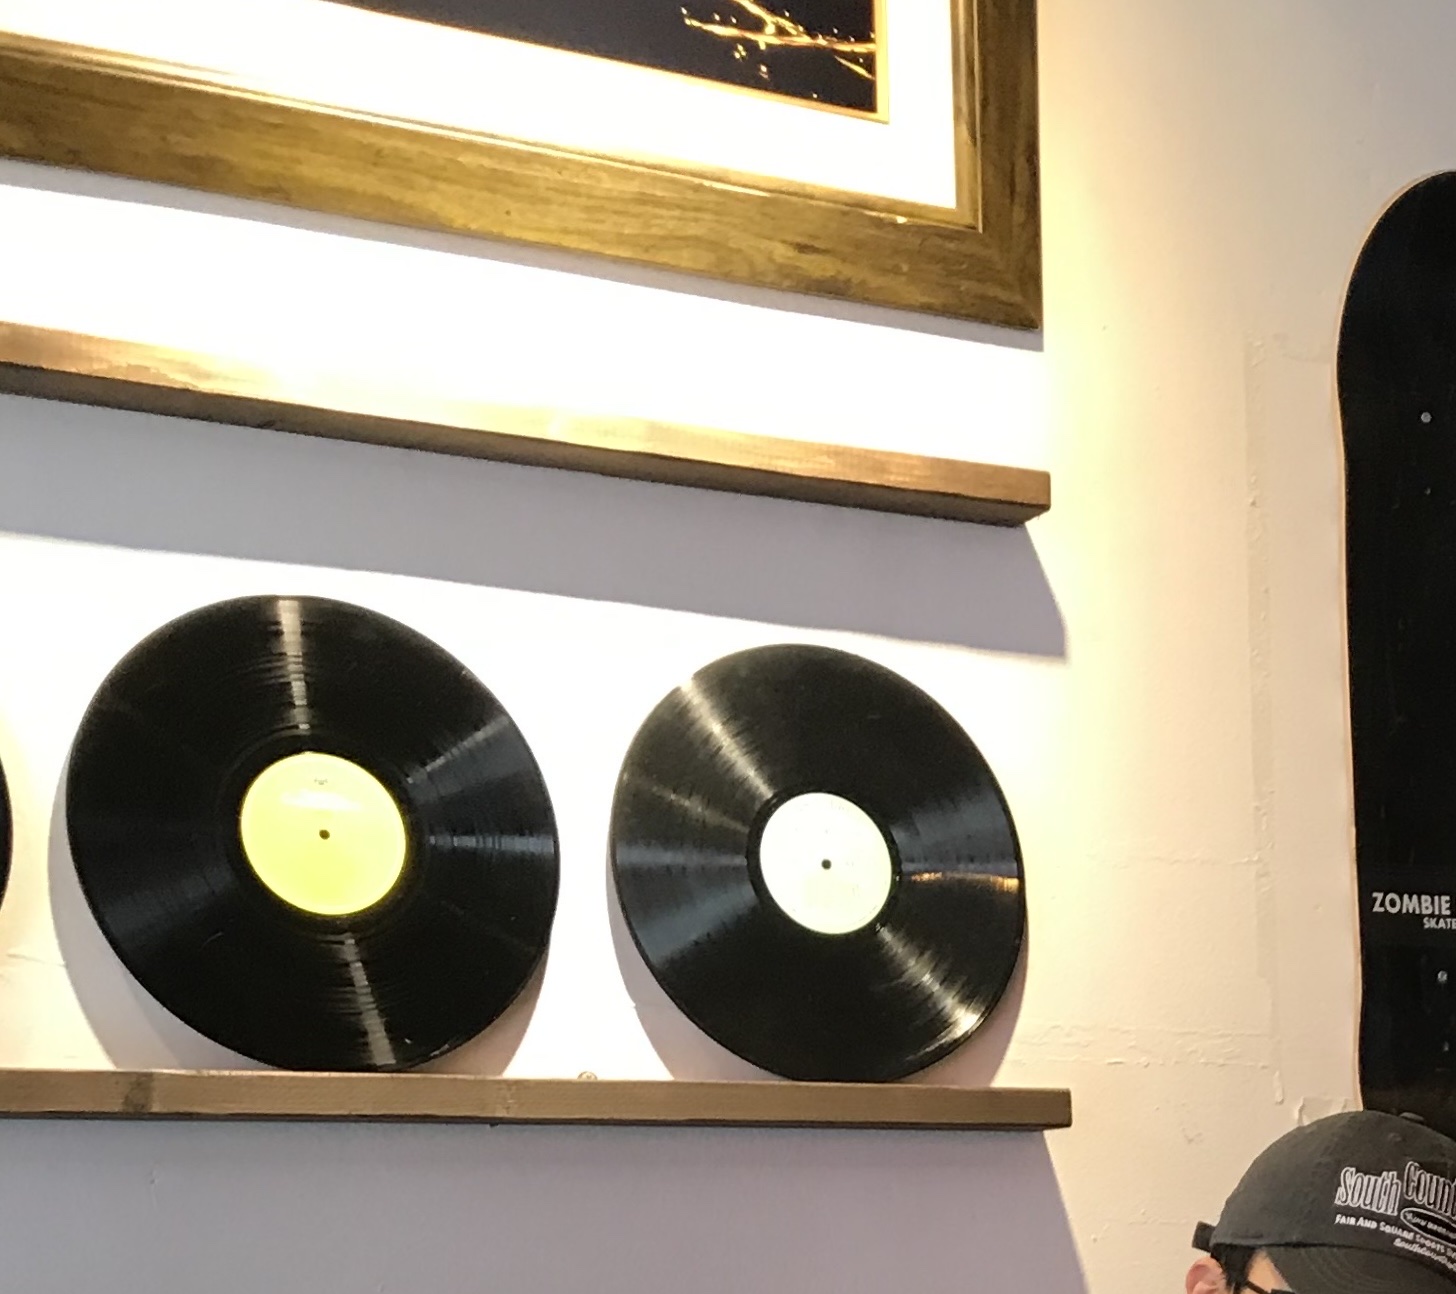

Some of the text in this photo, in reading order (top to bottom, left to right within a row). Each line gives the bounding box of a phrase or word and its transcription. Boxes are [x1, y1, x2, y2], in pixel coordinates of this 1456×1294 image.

[1372, 892, 1450, 916] ZOMBIE
[1334, 1166, 1402, 1216] South
[1334, 1214, 1356, 1226] FAIR
[1379, 1221, 1415, 1240] SQUARE
